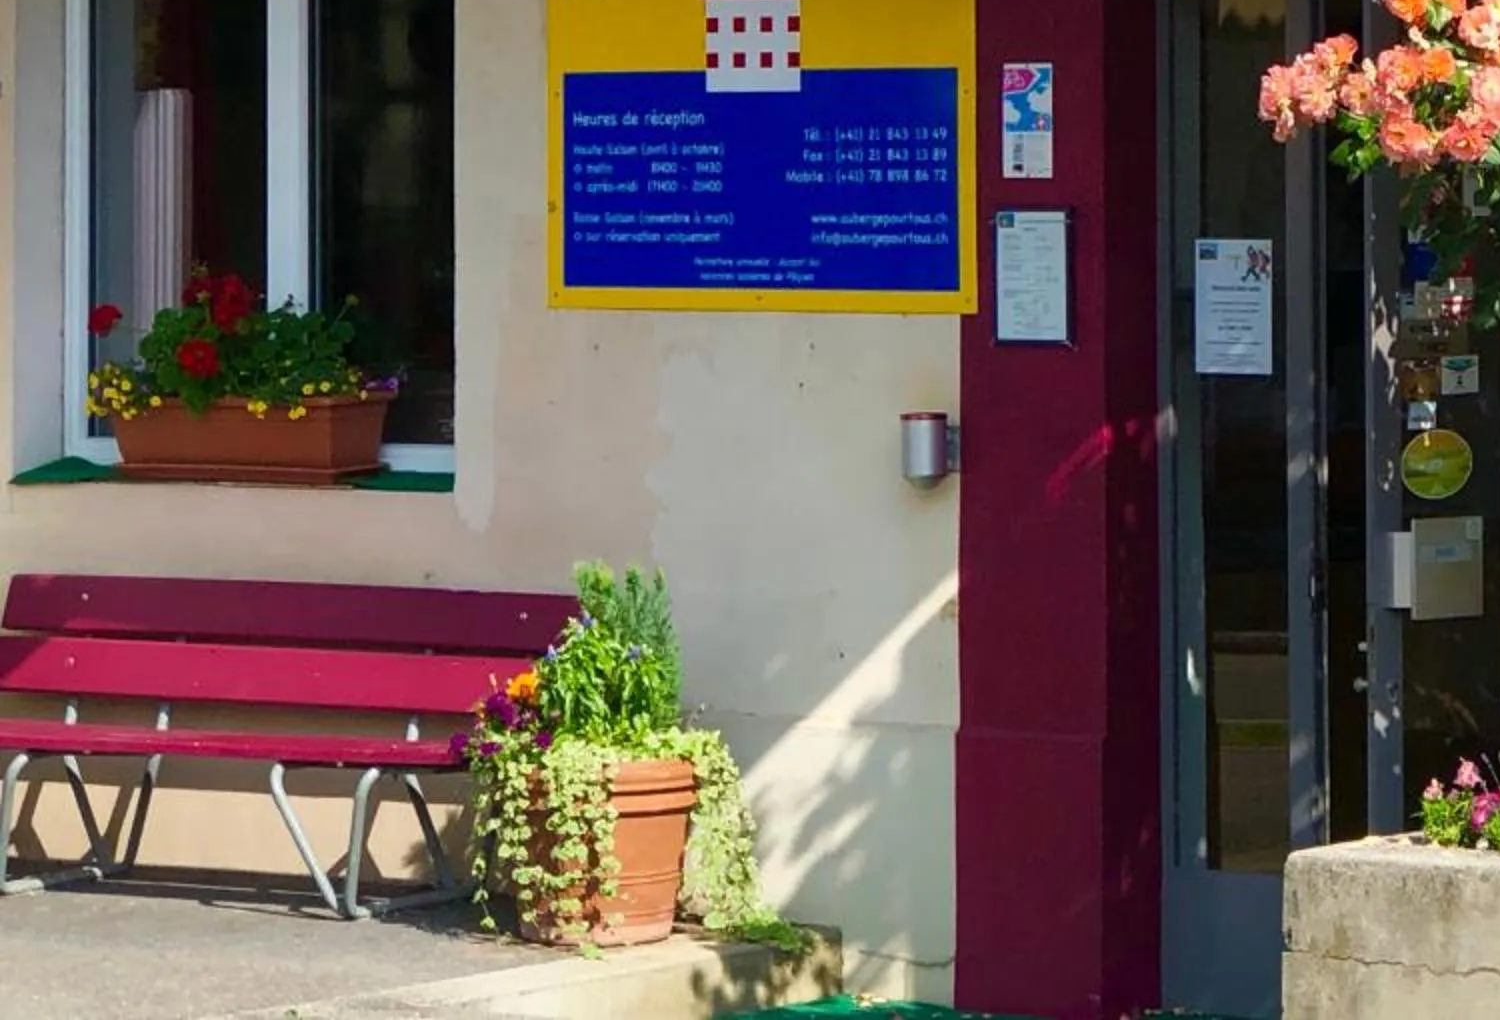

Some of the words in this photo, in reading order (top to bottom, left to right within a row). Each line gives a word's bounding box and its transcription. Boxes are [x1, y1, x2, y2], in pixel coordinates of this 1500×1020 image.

[572, 112, 618, 127] Heures
[622, 111, 639, 126] de
[644, 109, 705, 129] réception
